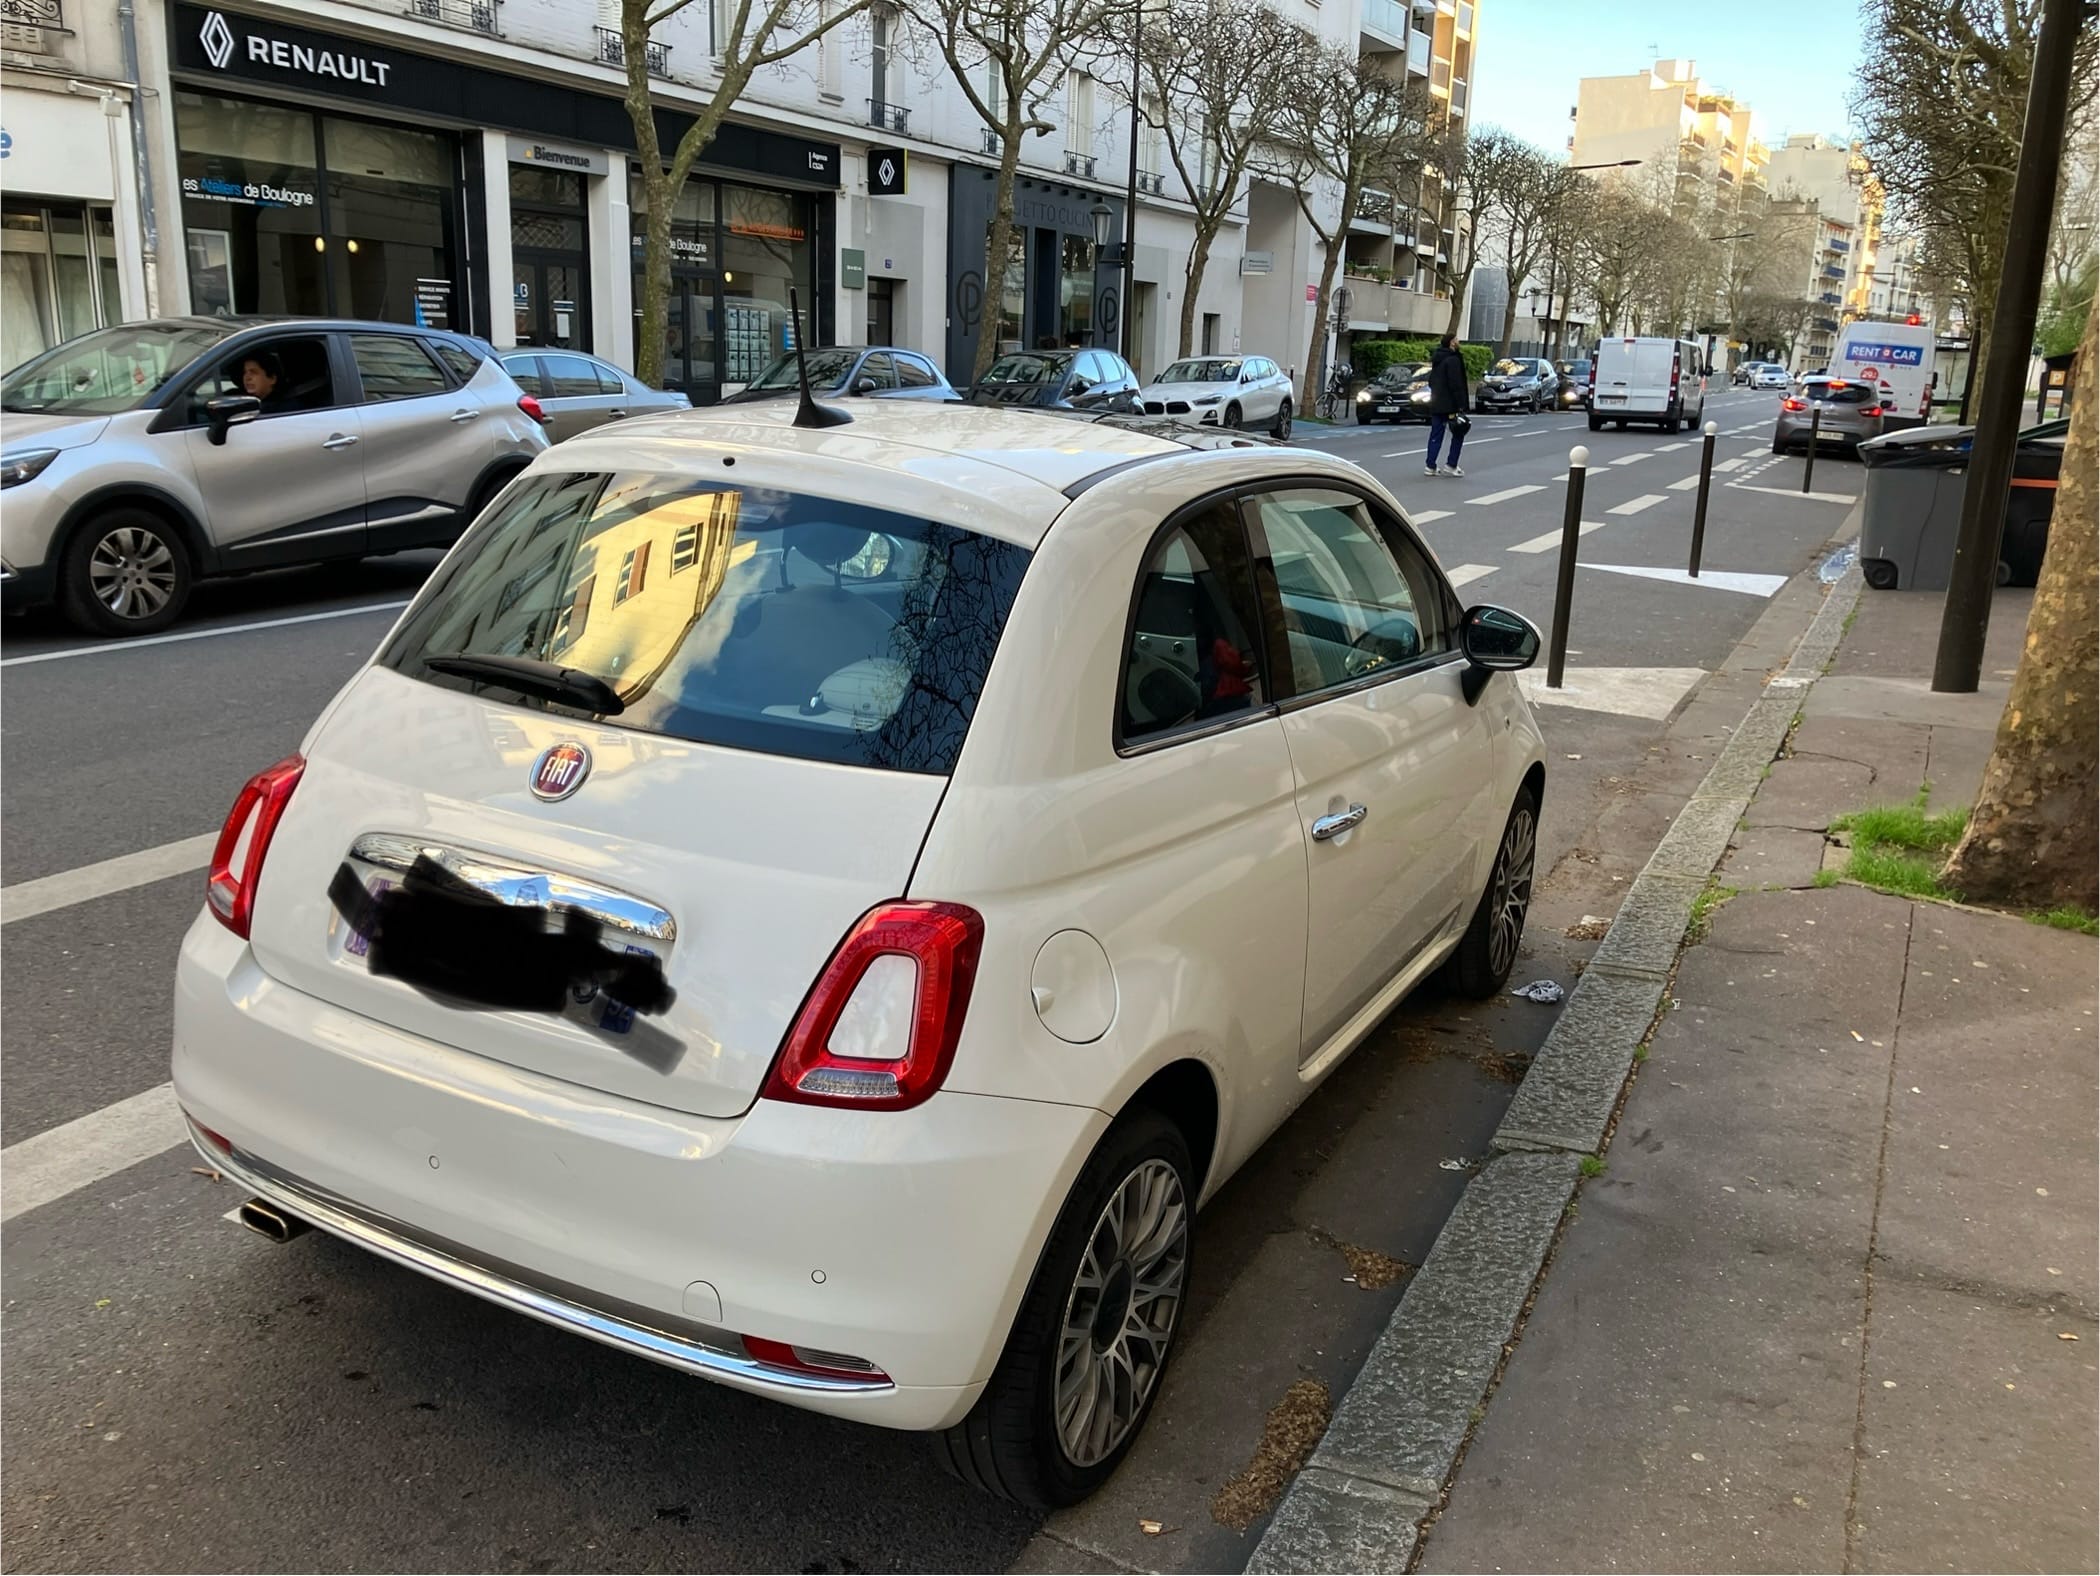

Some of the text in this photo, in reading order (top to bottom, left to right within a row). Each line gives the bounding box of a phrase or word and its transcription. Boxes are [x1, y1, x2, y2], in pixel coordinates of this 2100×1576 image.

[247, 35, 391, 87] RENAULT
[533, 145, 591, 168] Bienvenue
[200, 176, 241, 196] Ateliers
[243, 182, 259, 198] de
[260, 184, 313, 207] Boulogne
[677, 238, 707, 254] Boulogne
[1851, 346, 1881, 357] RENT
[1892, 350, 1917, 361] CAR
[540, 756, 579, 785] FIAT
